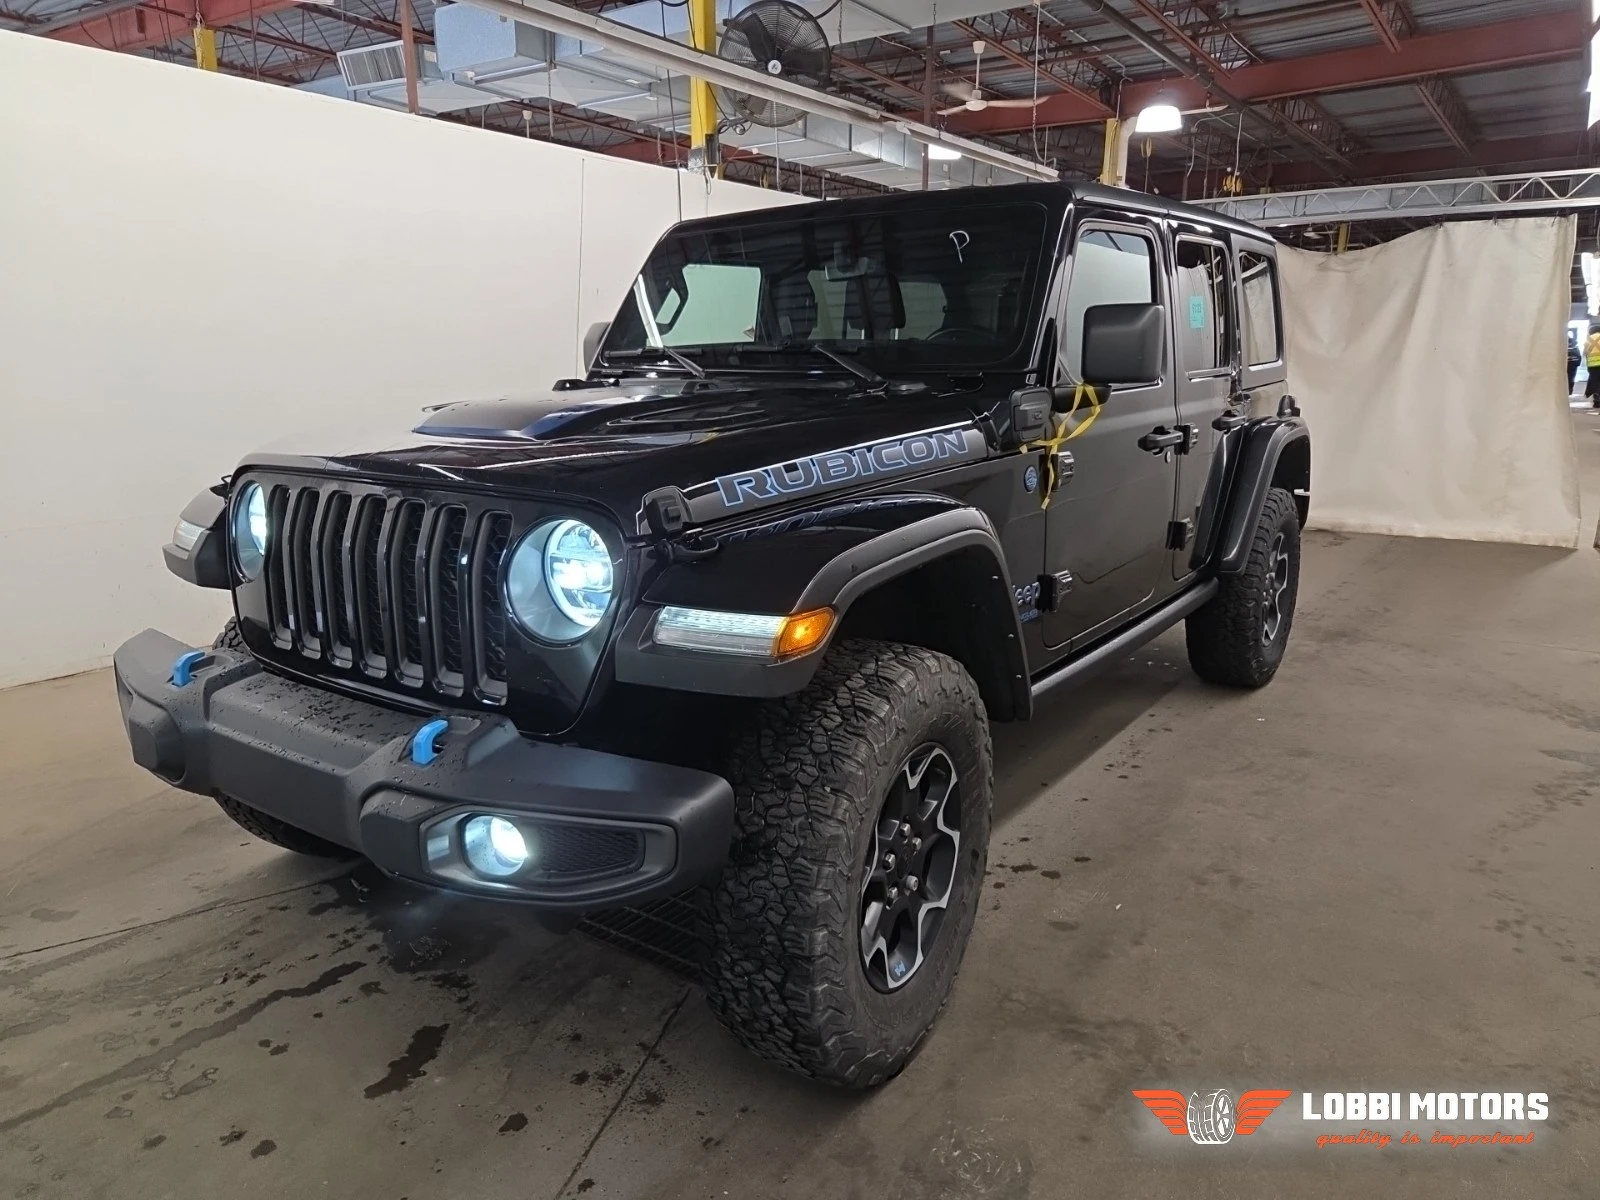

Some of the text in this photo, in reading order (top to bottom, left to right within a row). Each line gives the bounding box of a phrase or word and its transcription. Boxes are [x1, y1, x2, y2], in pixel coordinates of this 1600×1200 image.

[949, 230, 970, 263] P
[715, 429, 969, 507] RUBICON
[1012, 581, 1040, 609] eep
